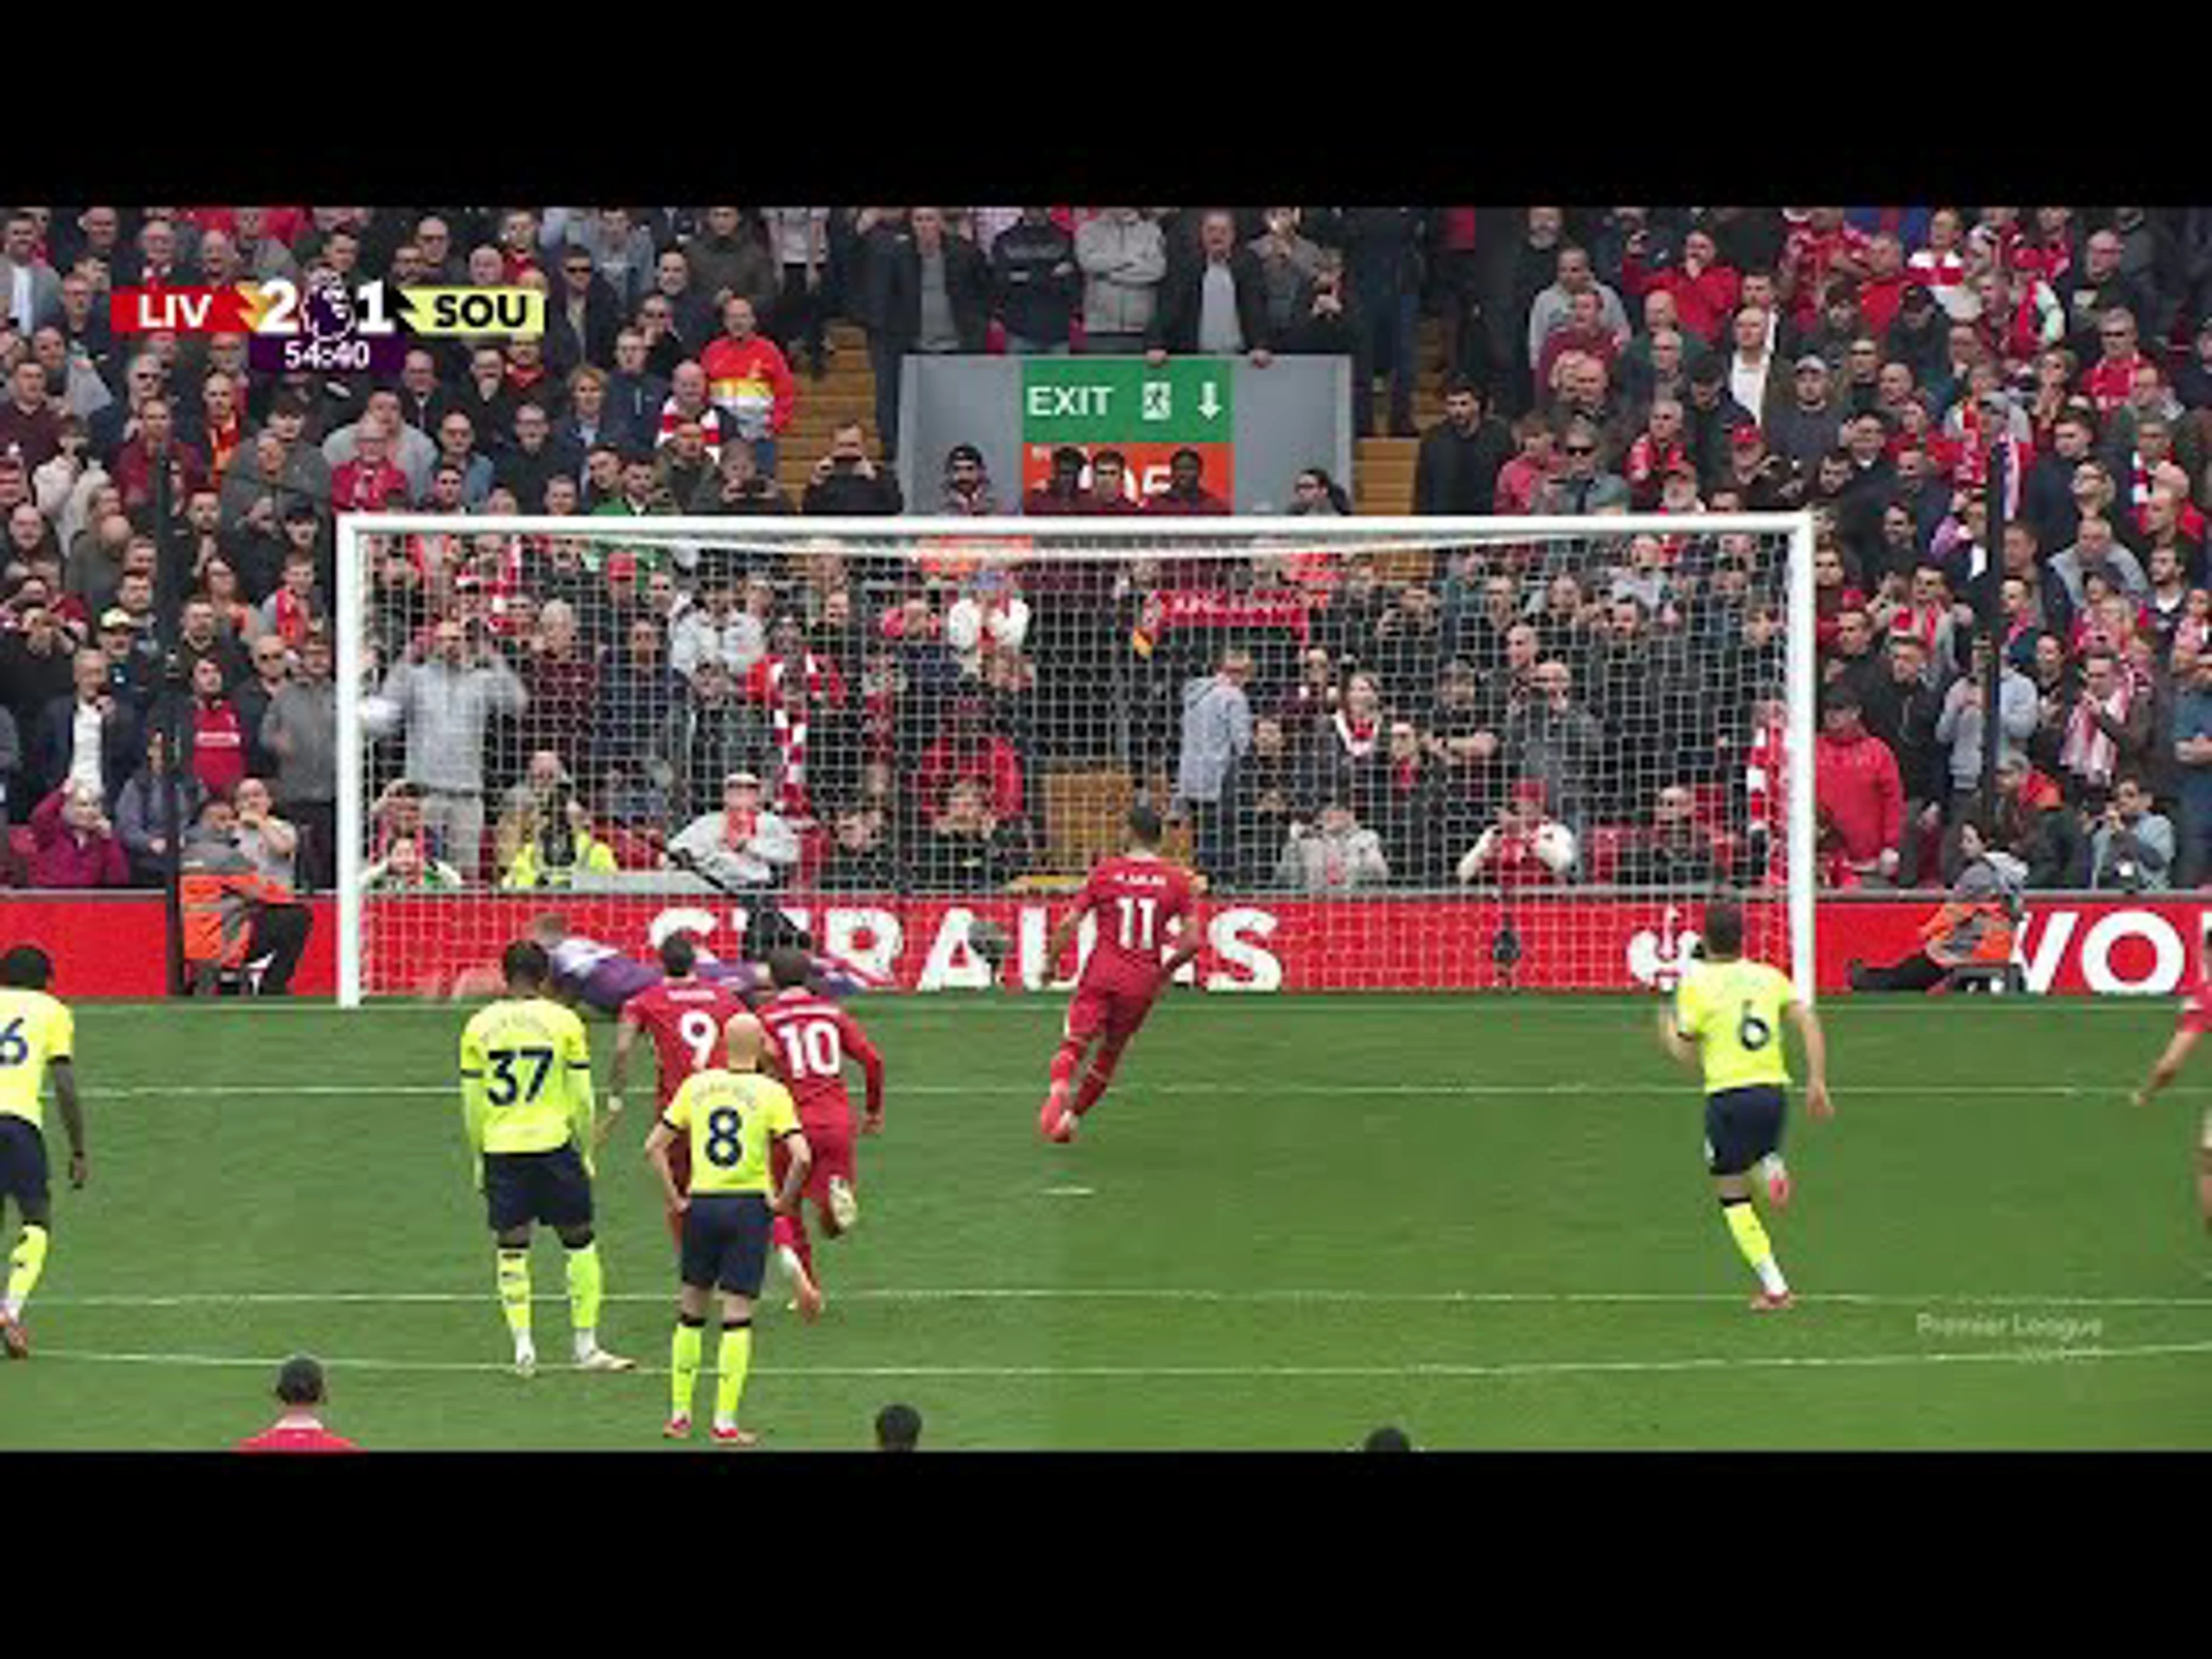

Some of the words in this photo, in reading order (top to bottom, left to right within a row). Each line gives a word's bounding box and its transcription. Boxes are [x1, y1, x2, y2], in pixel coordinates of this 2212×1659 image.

[1027, 385, 1115, 416] EXIT
[1116, 896, 1157, 950] 11
[681, 1009, 717, 1073] 9
[779, 1019, 840, 1079] 10
[1741, 999, 1771, 1052] 6
[488, 1046, 554, 1105] 37
[706, 1105, 744, 1168] 8
